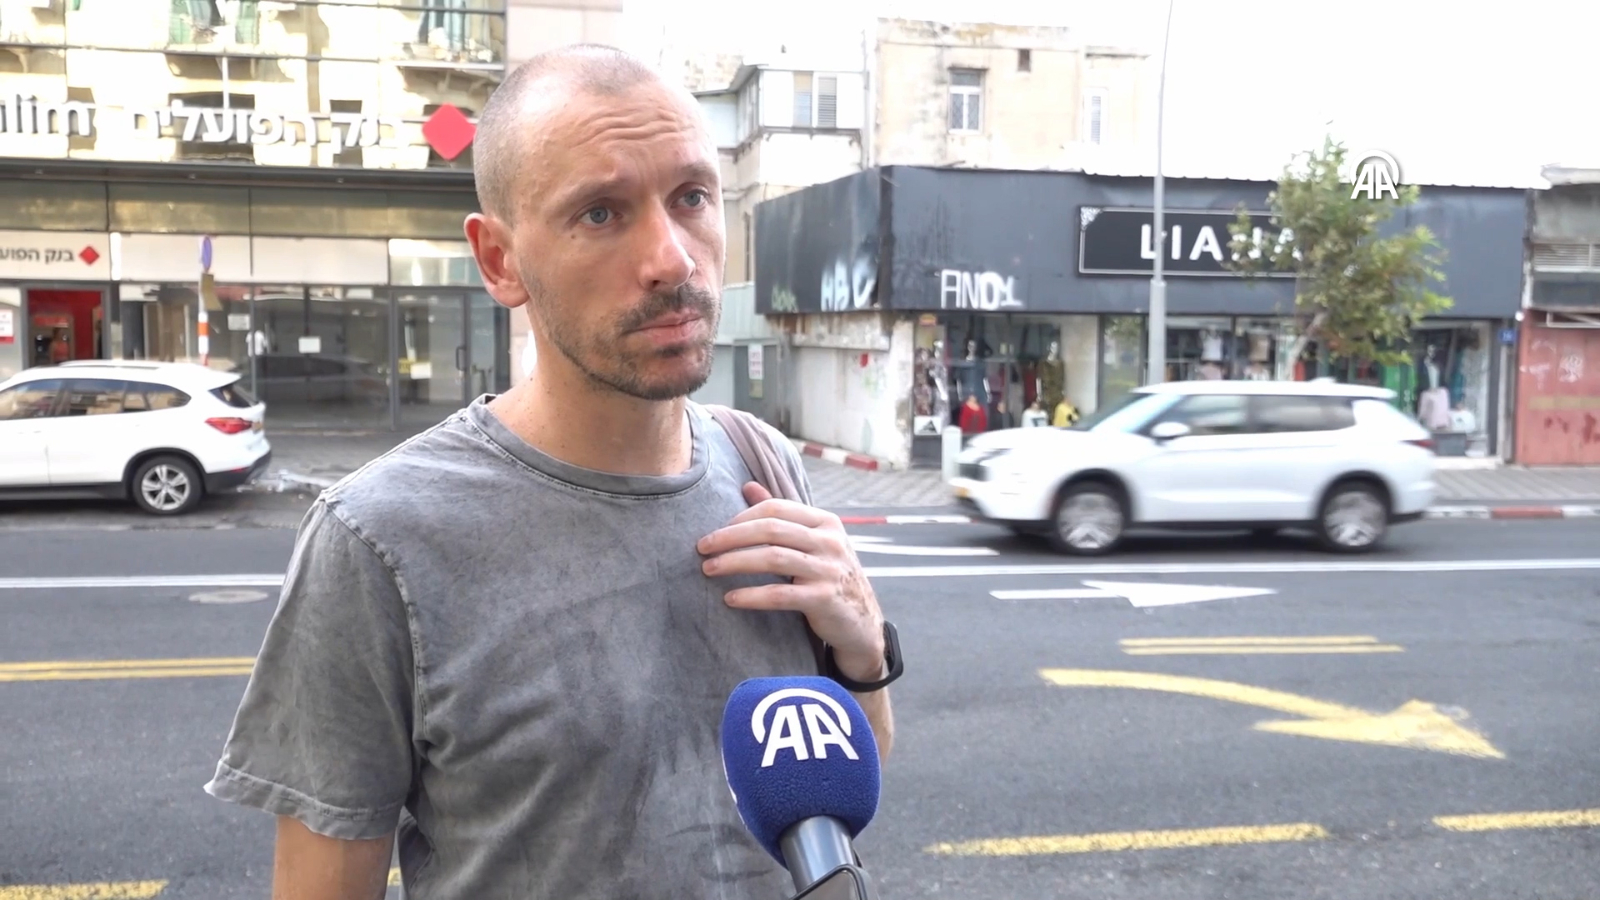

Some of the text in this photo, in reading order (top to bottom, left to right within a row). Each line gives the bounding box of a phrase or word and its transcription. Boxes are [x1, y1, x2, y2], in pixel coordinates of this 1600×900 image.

[0, 91, 90, 136] lim
[127, 98, 410, 155] בנק הפועלים
[44, 248, 75, 265] בנק
[760, 703, 860, 768] AA
